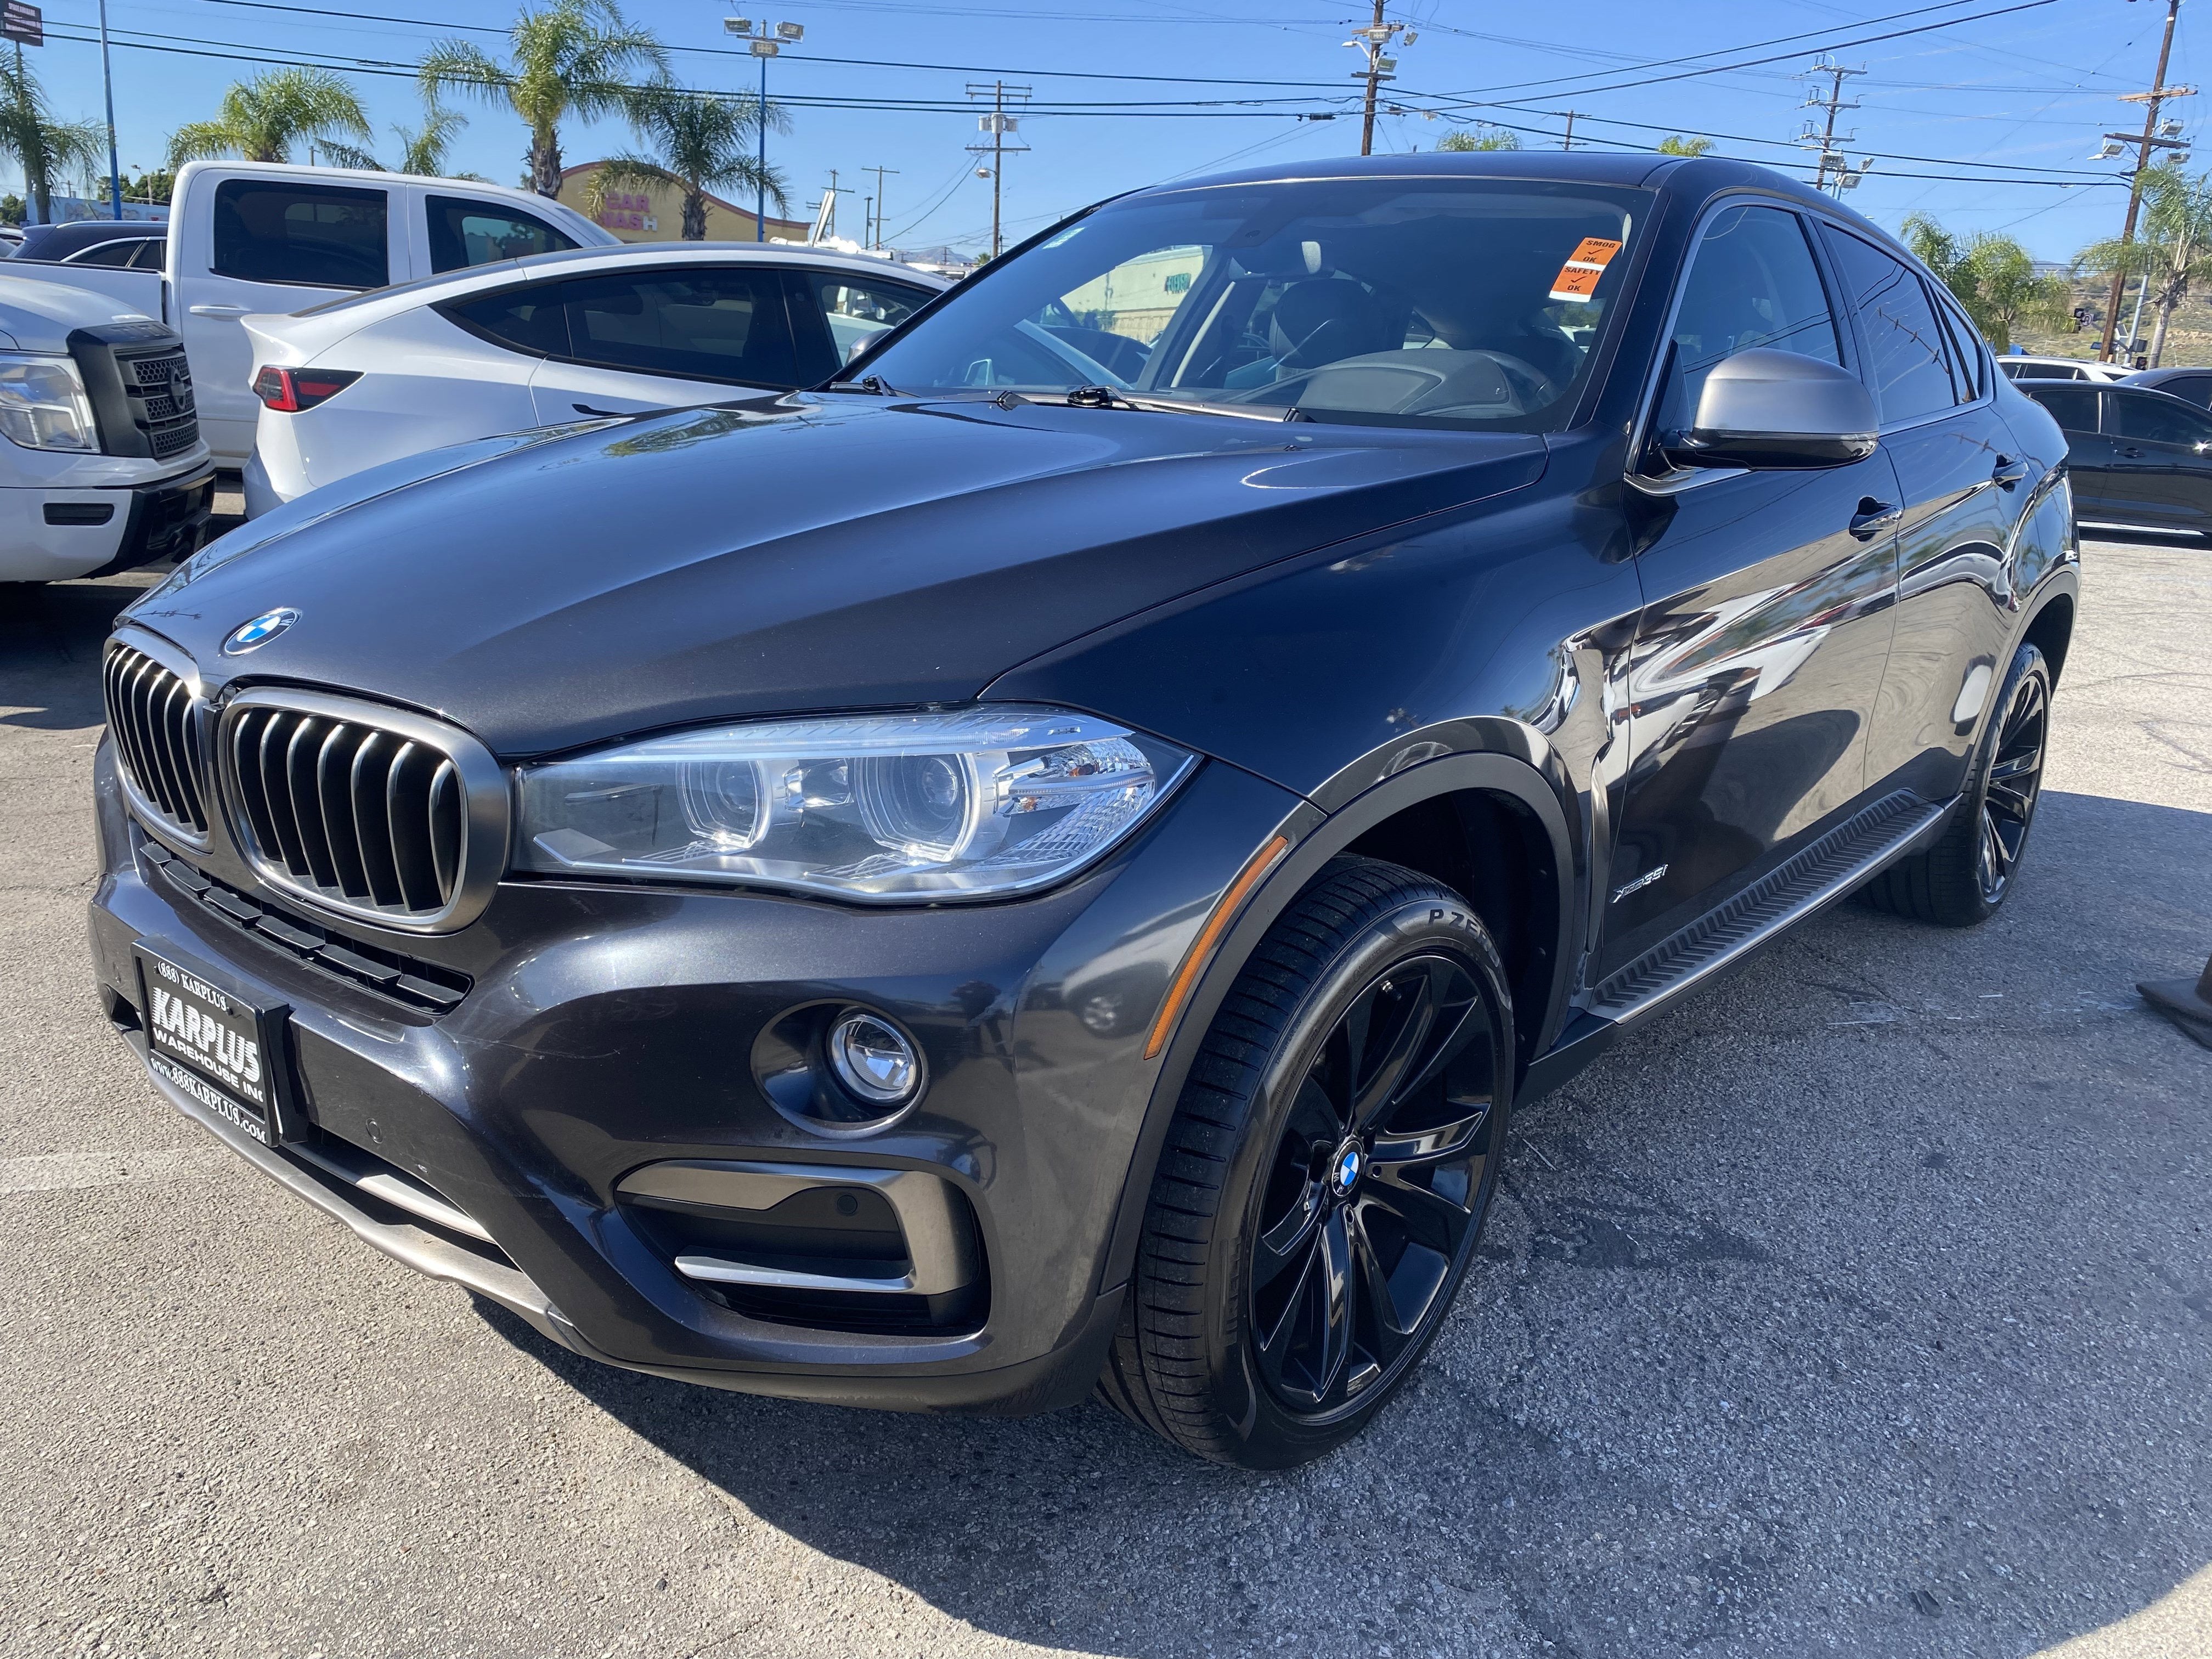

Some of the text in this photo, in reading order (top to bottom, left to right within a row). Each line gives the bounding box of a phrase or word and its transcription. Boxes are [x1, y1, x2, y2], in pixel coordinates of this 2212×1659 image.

[605, 192, 650, 213] CAR
[1585, 240, 1616, 249] SMOG
[1564, 267, 1602, 275] SAFETY
[1428, 909, 1444, 926] P
[157, 961, 227, 1011] (888) KARPLUS
[151, 986, 261, 1083] KARPLUS
[153, 1027, 240, 1089] WAREHOUSE
